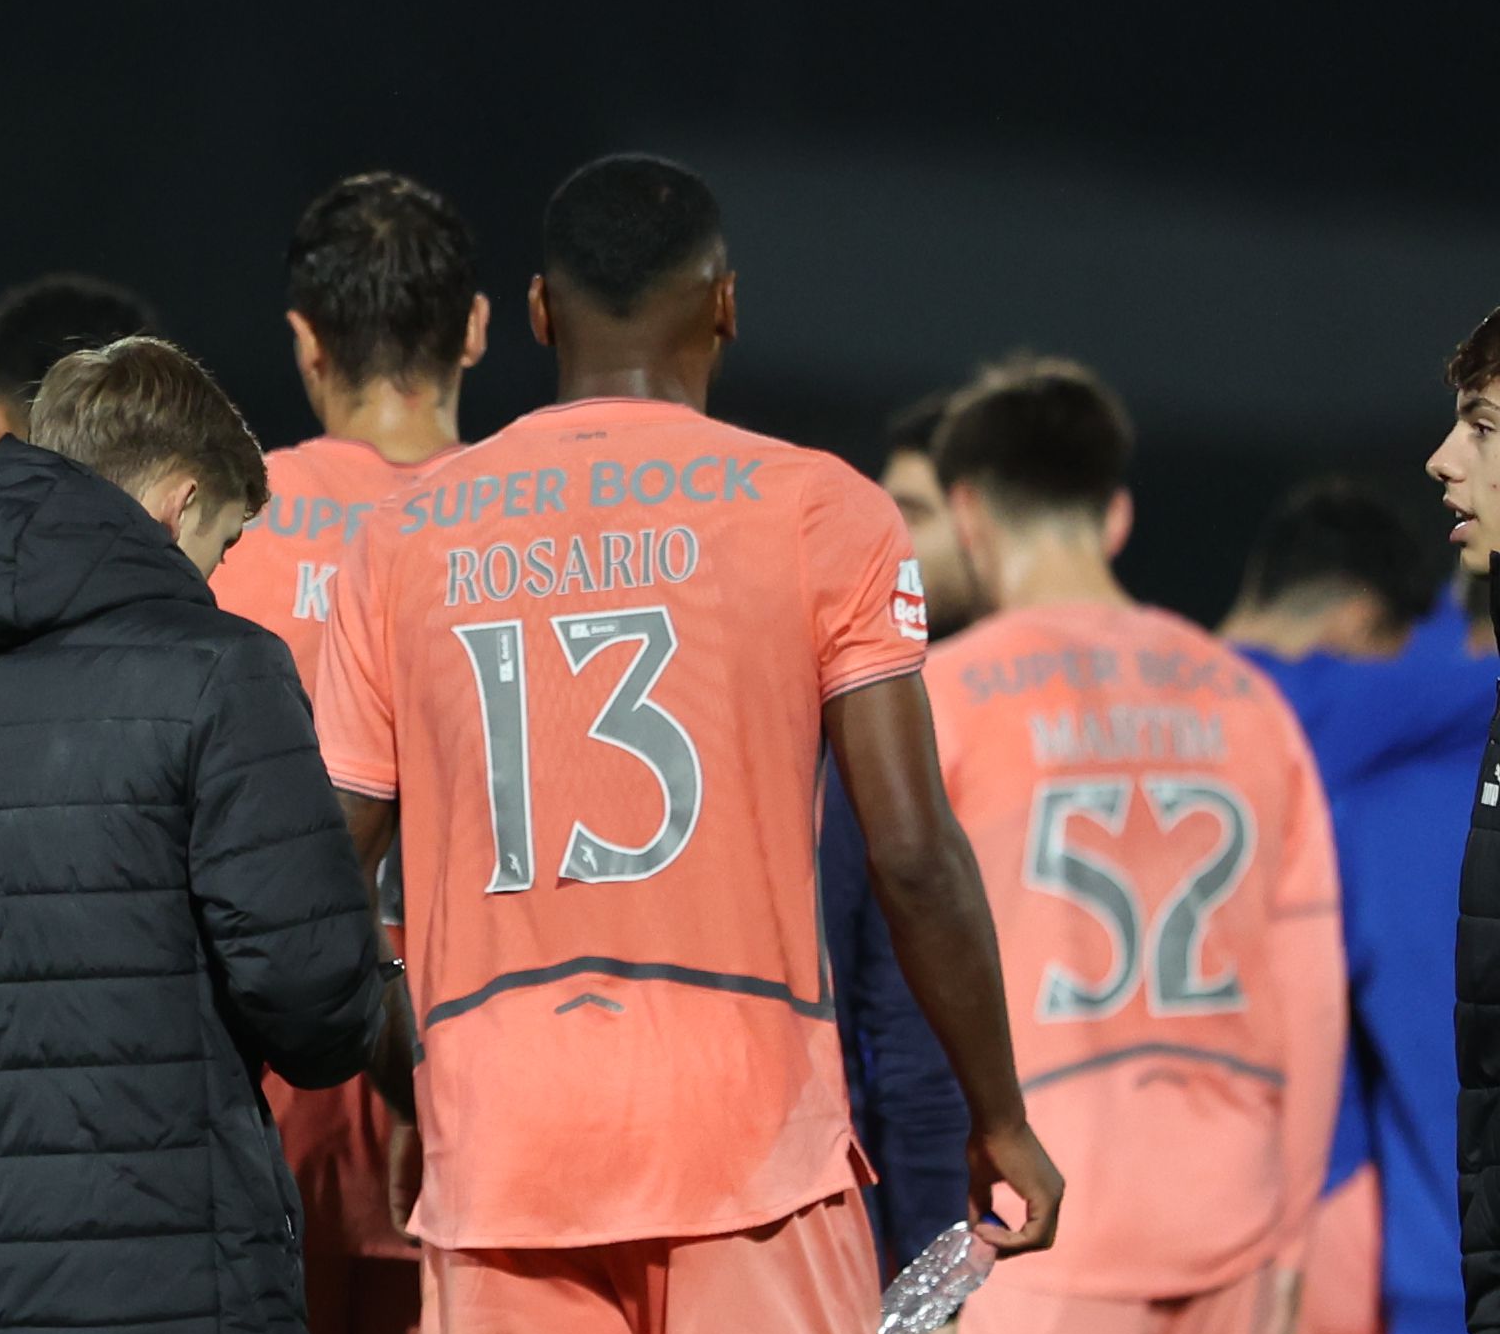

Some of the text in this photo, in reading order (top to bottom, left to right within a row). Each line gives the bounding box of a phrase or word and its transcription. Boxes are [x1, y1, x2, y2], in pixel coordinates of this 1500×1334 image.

[399, 455, 764, 535] SUPER BOCK
[292, 562, 338, 622] K
[443, 525, 700, 606] ROSARIO
[962, 649, 1117, 705] SUPER
[452, 605, 703, 894] 13
[1020, 772, 1258, 1025] 52
